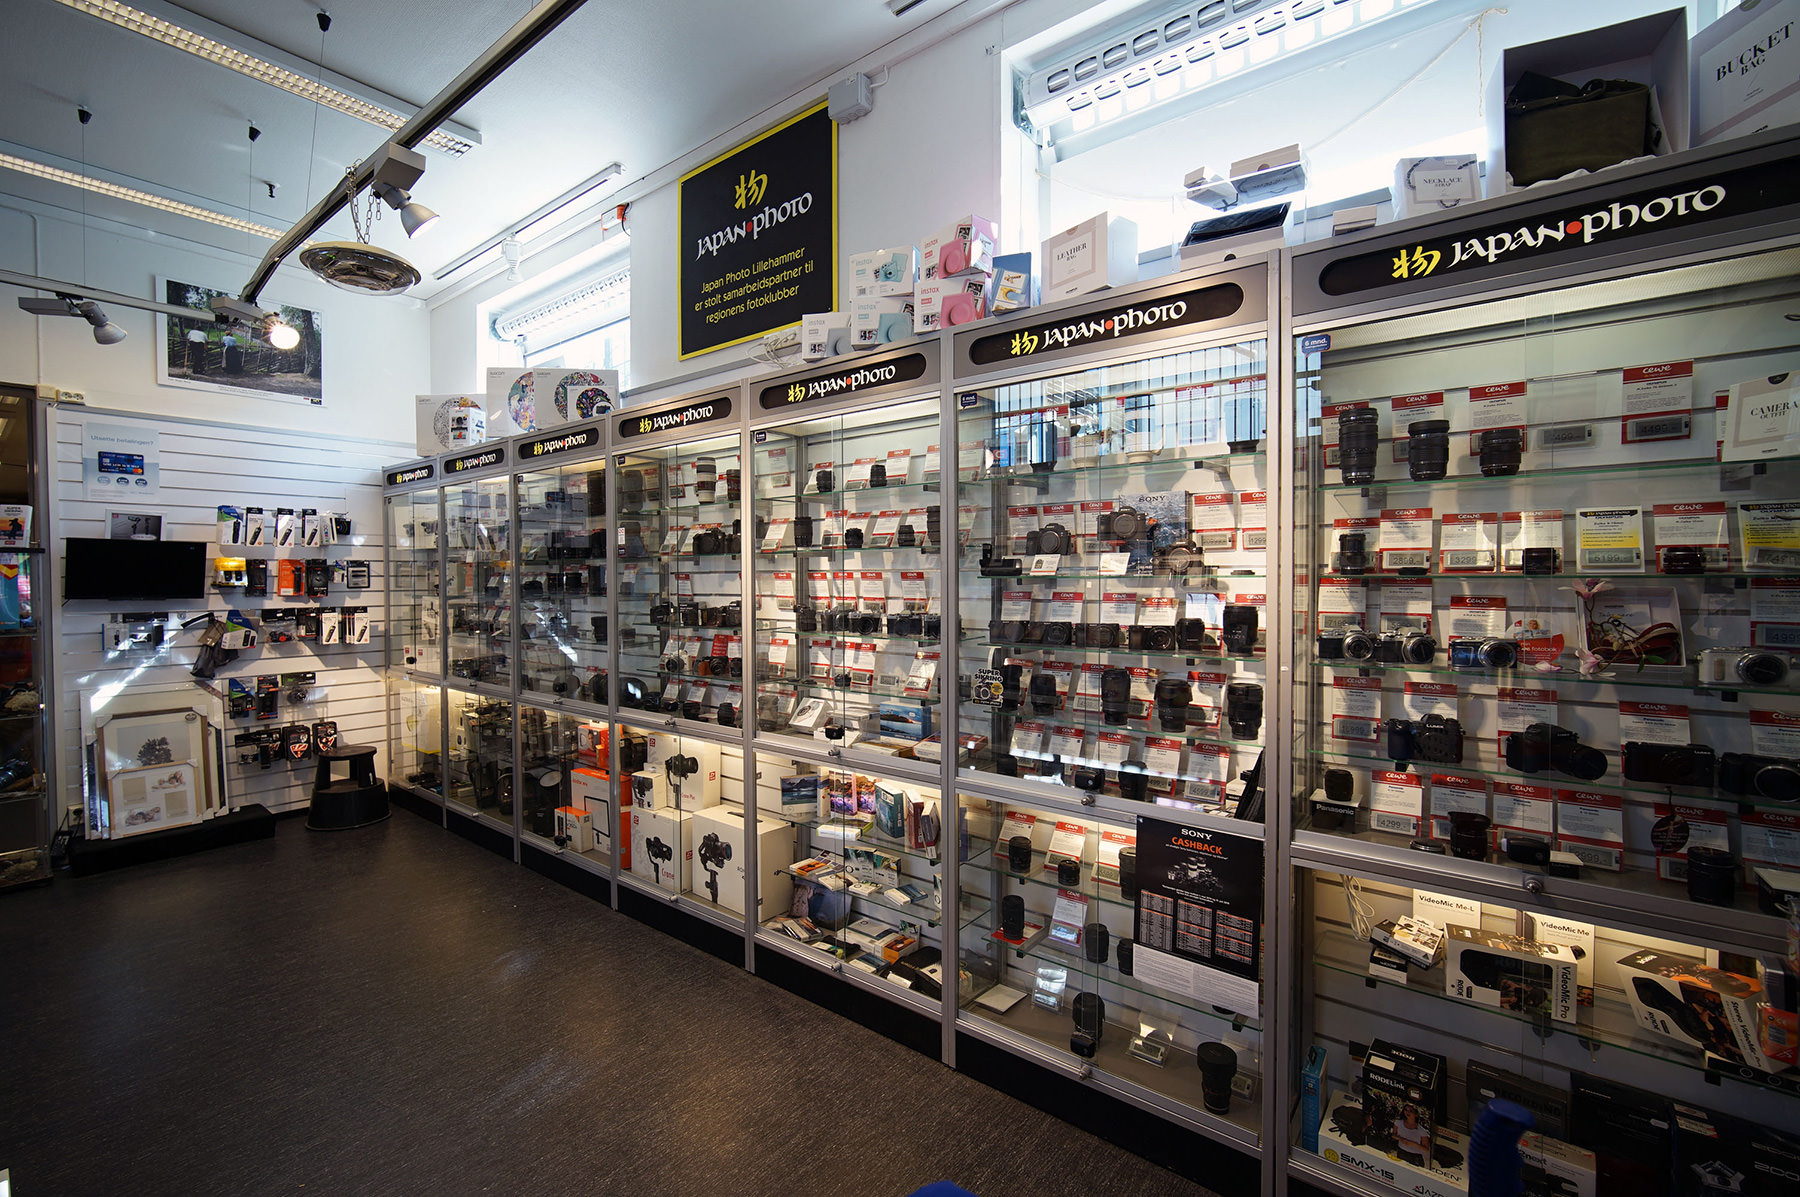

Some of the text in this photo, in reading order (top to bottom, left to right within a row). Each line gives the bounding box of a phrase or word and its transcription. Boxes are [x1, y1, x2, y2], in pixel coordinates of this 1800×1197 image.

[1716, 21, 1794, 81] BUCKET
[1741, 54, 1766, 76] BAG
[1423, 176, 1463, 186] NECKLACE
[1056, 242, 1087, 261] LEATHER
[701, 247, 805, 294] Japan Photo Lillehammer
[694, 260, 814, 311] er stolt samarbeidspartner til
[706, 285, 801, 324] regionens fotoklubber
[1642, 364, 1672, 374] cewe
[1485, 384, 1510, 393] cewe
[1750, 400, 1800, 417] CAMERA
[1759, 411, 1787, 419] OUTFIT
[974, 673, 1003, 681] SIKRING
[978, 668, 1000, 676] SUPER
[1639, 703, 1668, 711] cewe
[1386, 772, 1407, 780] cewe
[1510, 784, 1535, 793] cewe
[1576, 792, 1603, 801] cewe
[1316, 803, 1354, 816] Panasonic
[1675, 806, 1704, 815] cewe
[1763, 813, 1796, 823] cewe
[1181, 828, 1213, 840] SONY
[1171, 836, 1223, 855] CASHBACK
[1419, 895, 1475, 912] VideoMic Me-L
[1541, 921, 1576, 934] VideoMic
[1560, 966, 1571, 1019] VideoMic Pro
[1731, 1000, 1743, 1024] Stereo
[1340, 1153, 1395, 1181] SMX-15
